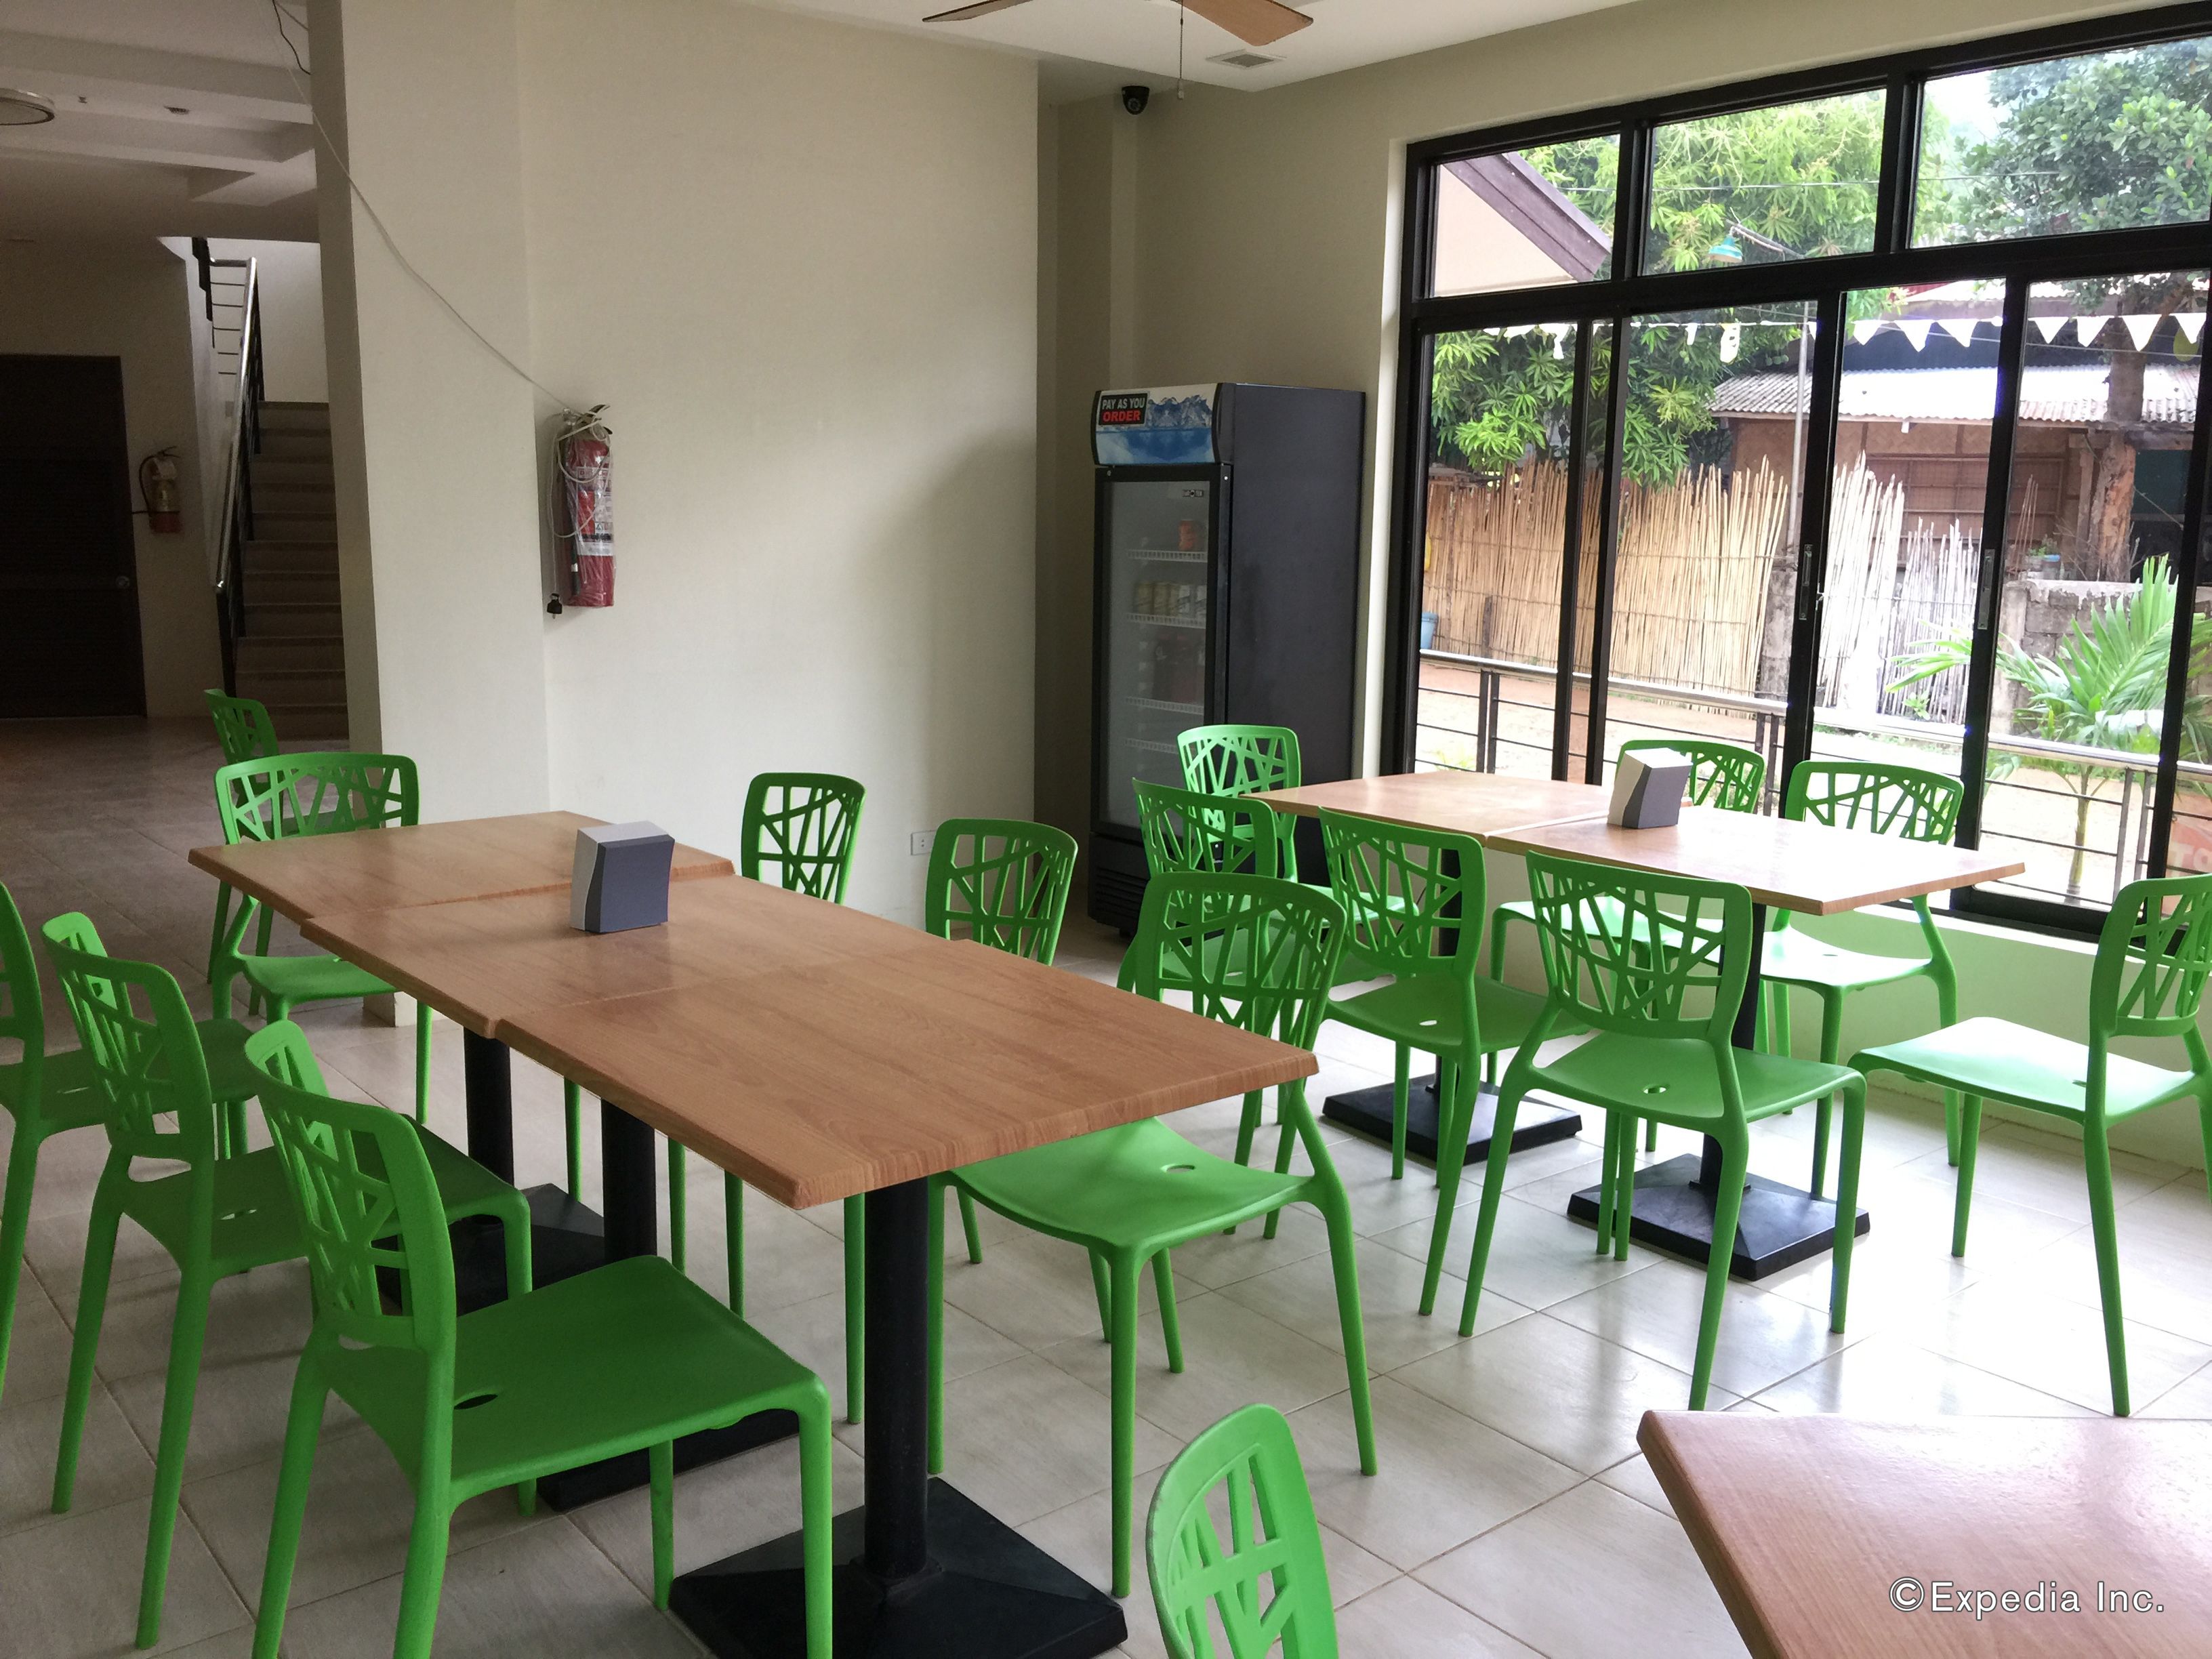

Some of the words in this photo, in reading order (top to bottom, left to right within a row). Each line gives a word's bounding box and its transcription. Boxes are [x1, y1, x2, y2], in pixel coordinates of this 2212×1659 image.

[1103, 399, 1116, 409] PAY
[1117, 398, 1128, 409] AS
[1130, 398, 1145, 408] YOU
[1103, 411, 1140, 422] ORDER
